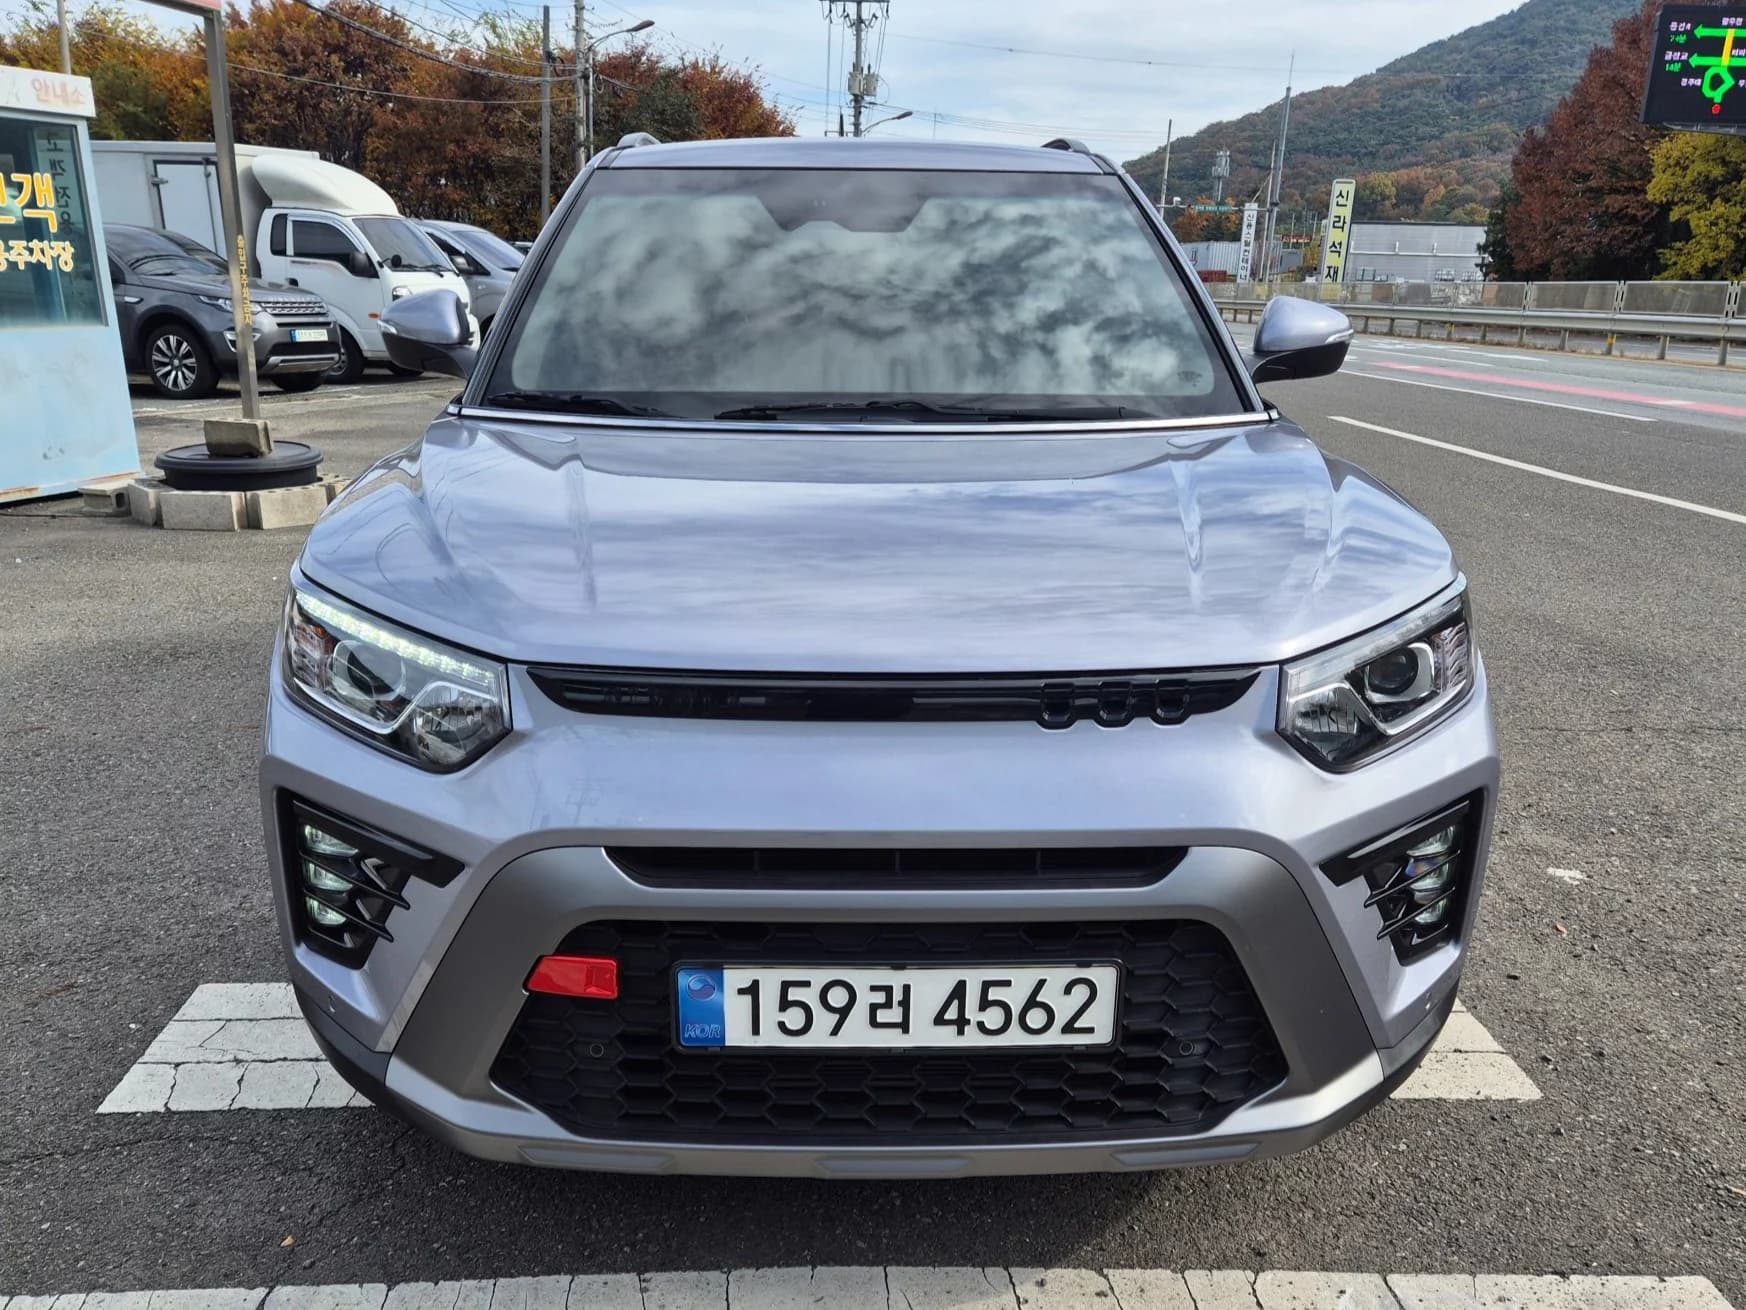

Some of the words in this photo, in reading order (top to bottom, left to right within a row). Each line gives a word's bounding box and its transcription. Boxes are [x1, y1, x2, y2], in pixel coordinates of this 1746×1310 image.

[31, 78, 85, 105] 안내소
[1325, 189, 1350, 283] 신라석재
[736, 978, 912, 1037] 159러
[932, 977, 1099, 1037] 4562
[684, 1023, 721, 1039] KOR
